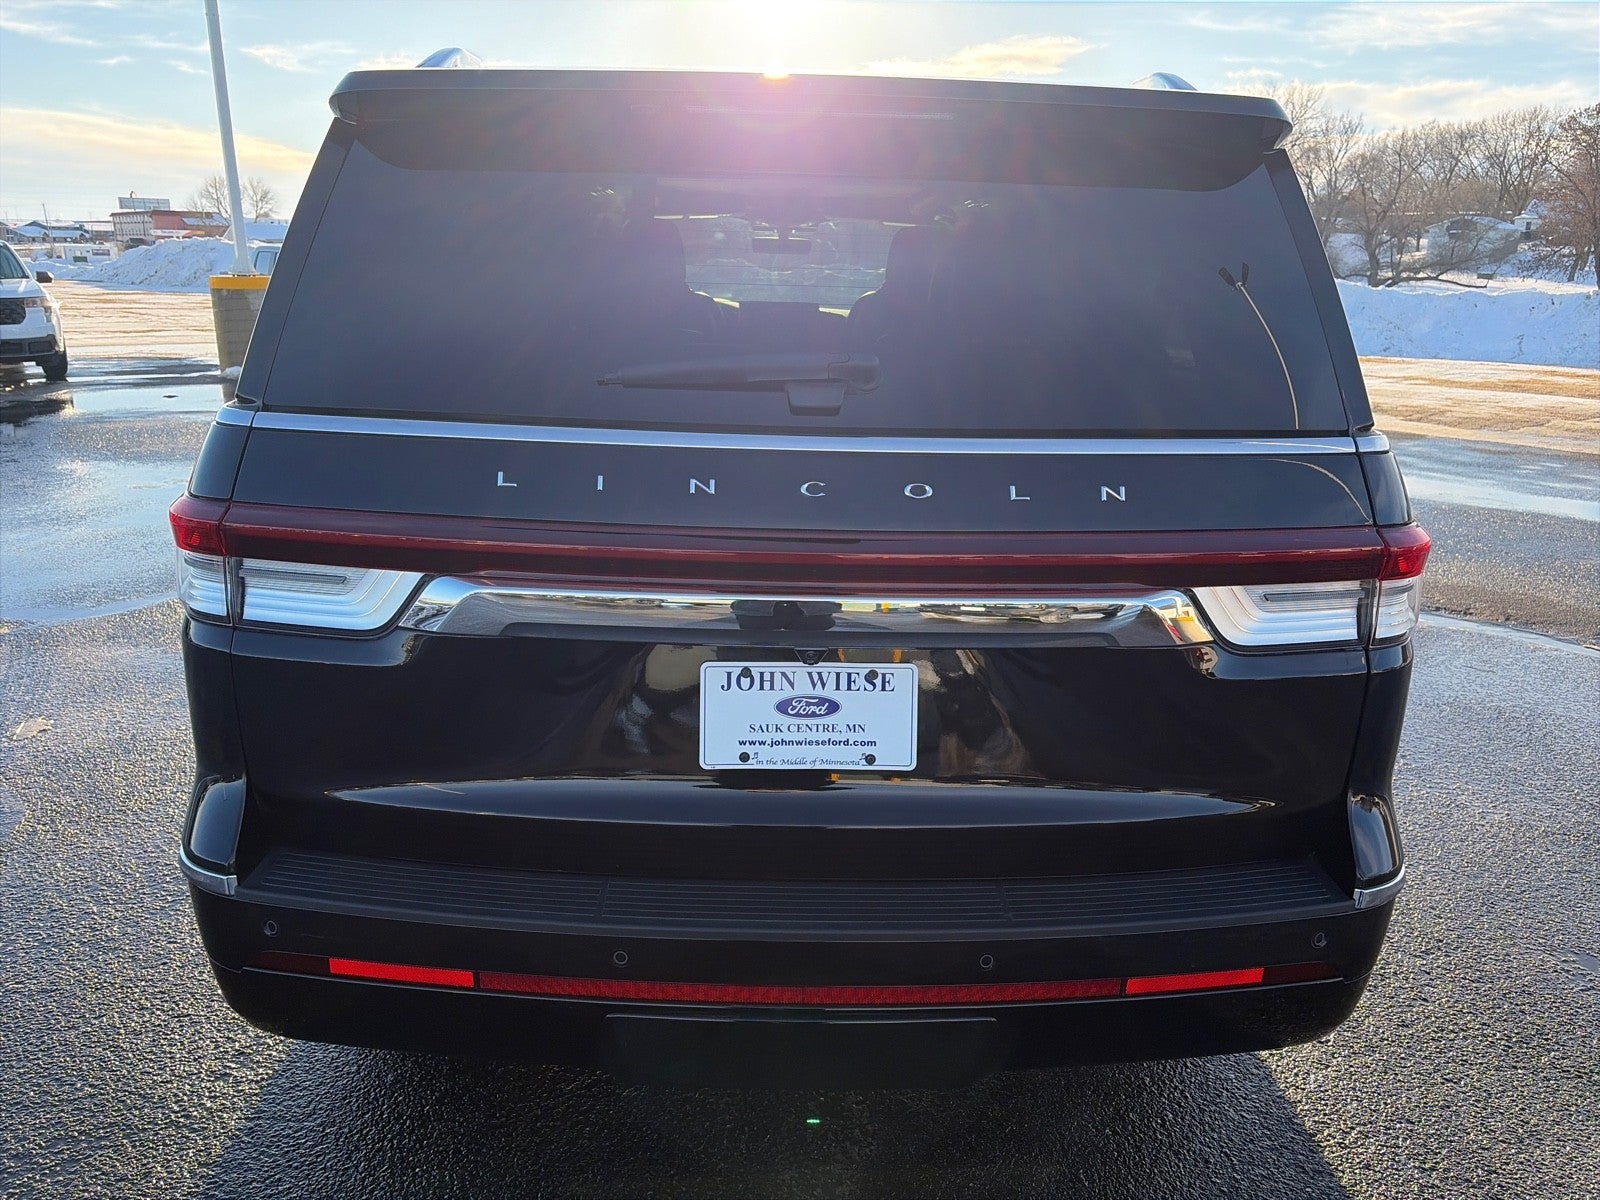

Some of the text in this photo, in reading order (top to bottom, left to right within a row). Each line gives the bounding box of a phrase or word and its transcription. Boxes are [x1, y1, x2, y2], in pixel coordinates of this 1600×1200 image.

[497, 471, 1126, 502] LINCOLN
[720, 670, 895, 692] JOHN WIESE
[788, 698, 828, 715] Ford
[749, 723, 866, 735] SAUK CENTRE, MN
[738, 738, 877, 748] www.johnwieseford.com
[756, 757, 860, 768] in the Middle of Minnesota
